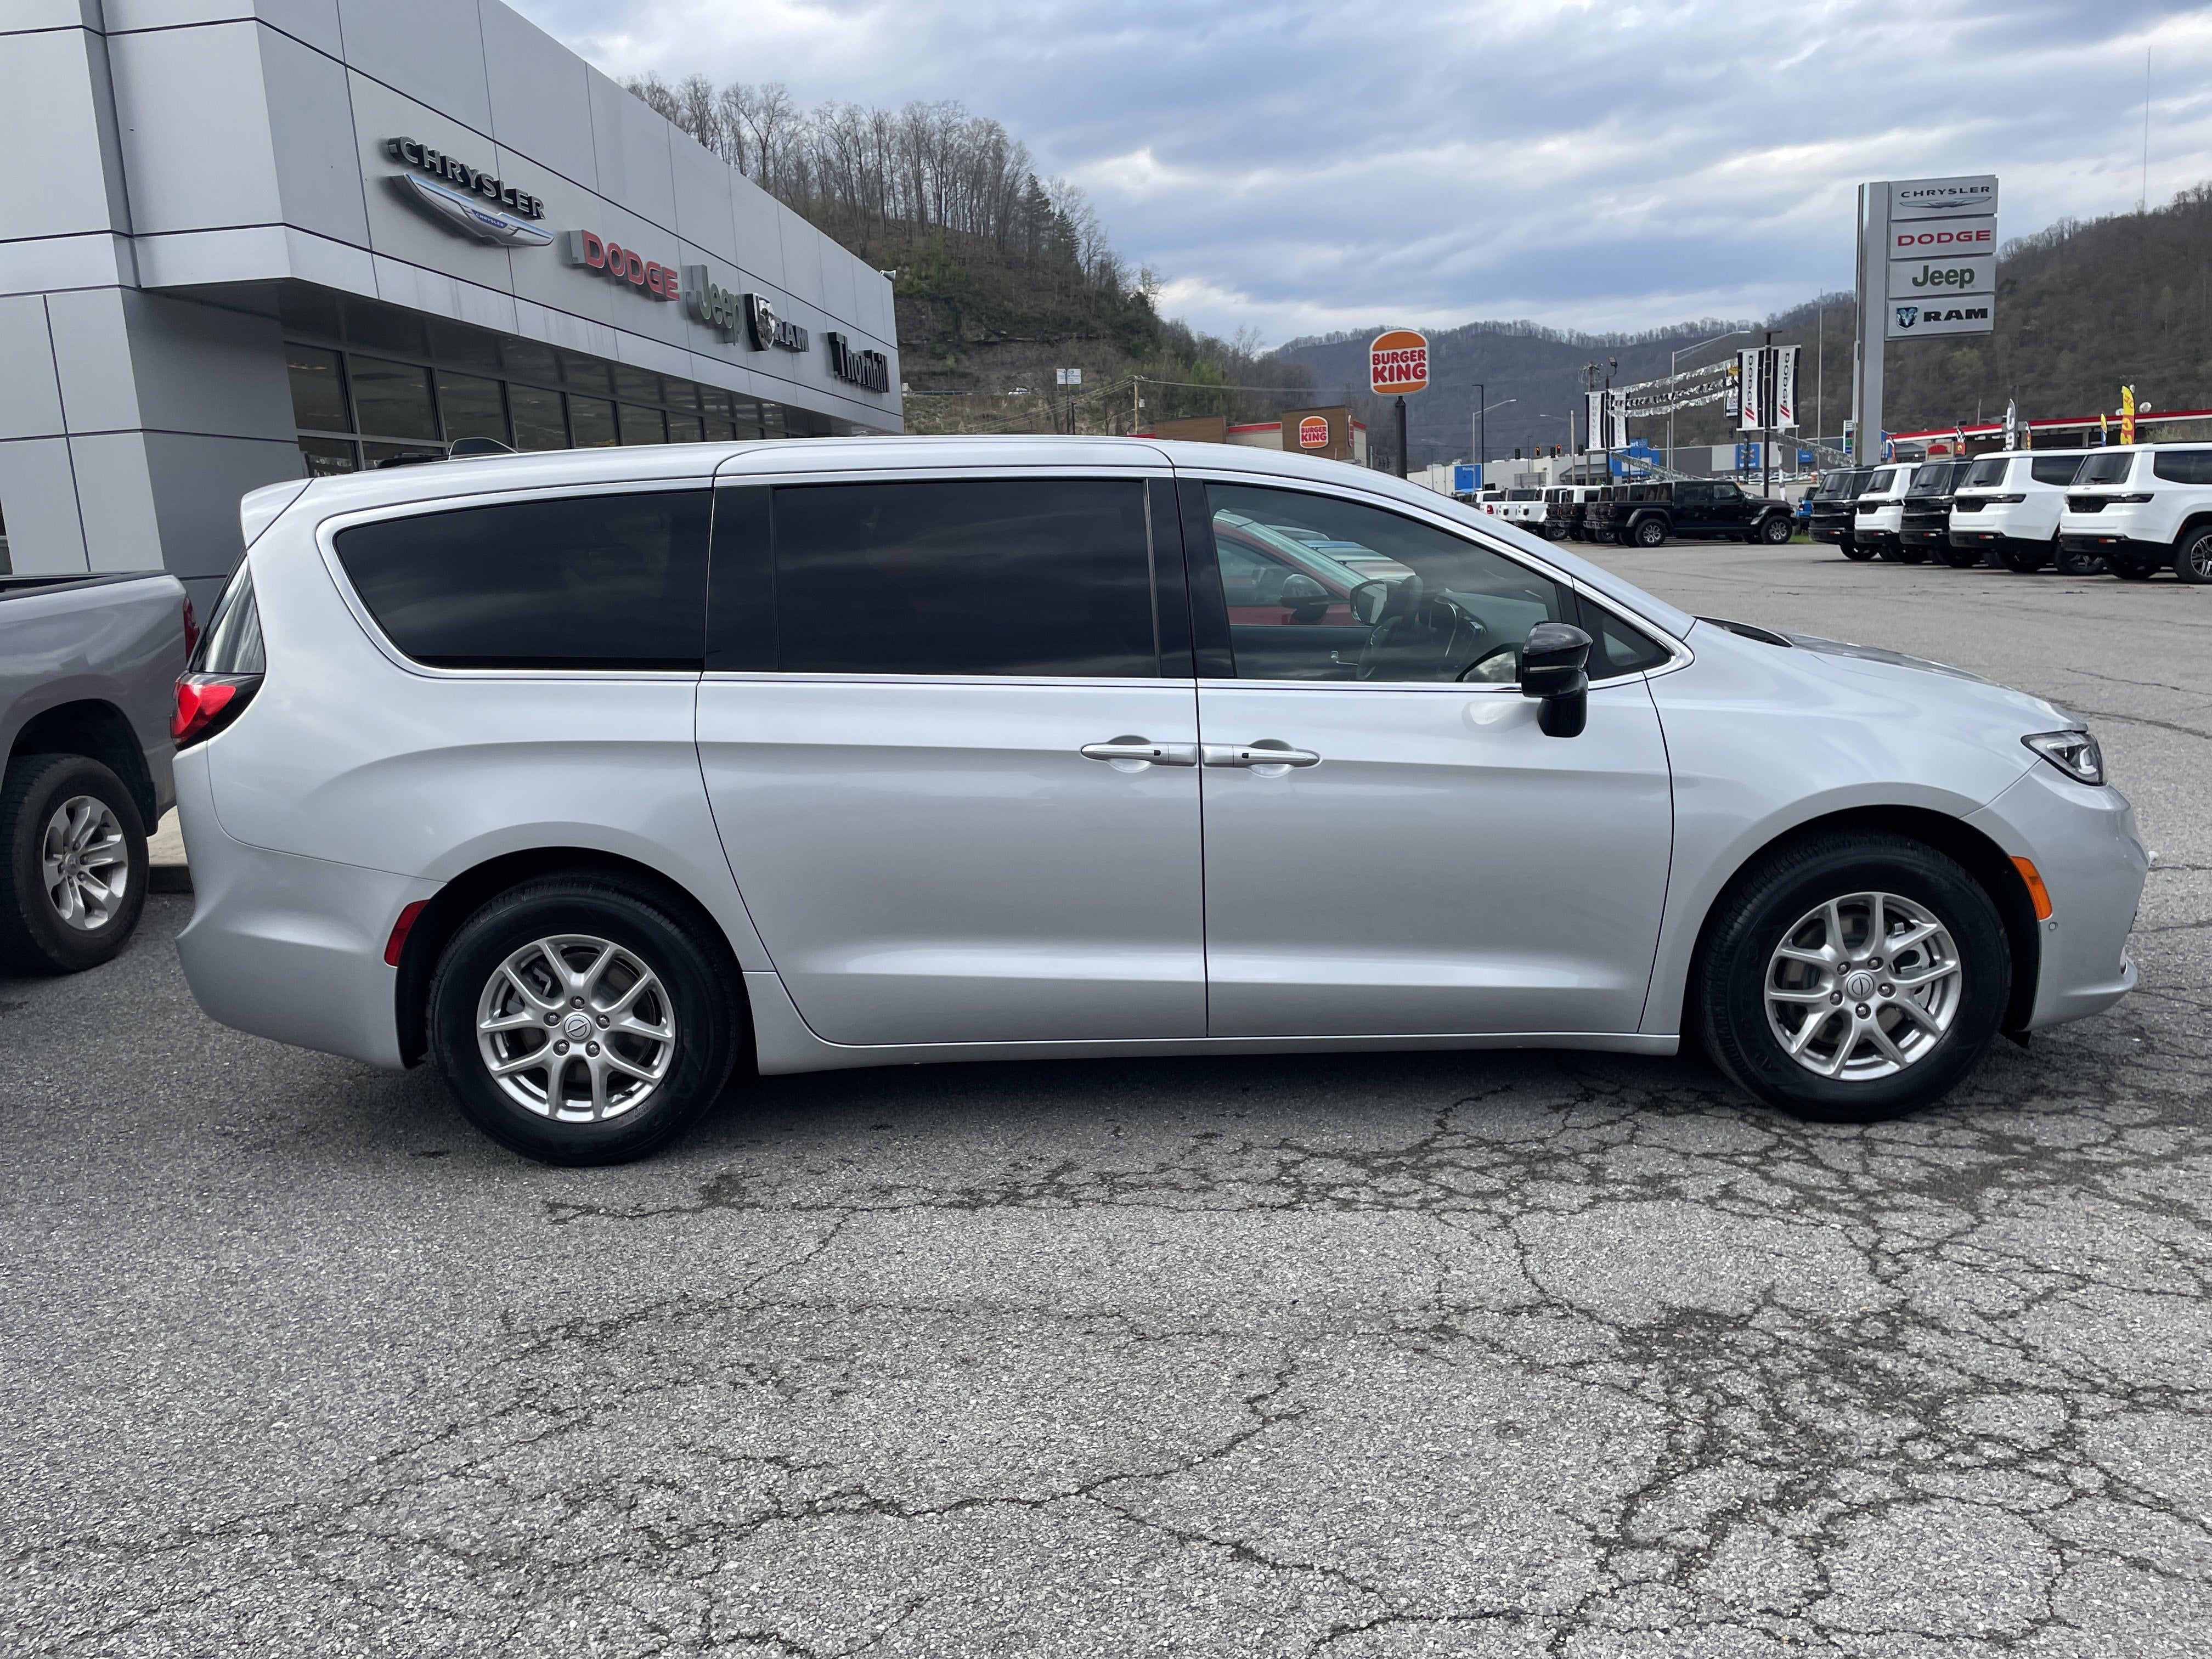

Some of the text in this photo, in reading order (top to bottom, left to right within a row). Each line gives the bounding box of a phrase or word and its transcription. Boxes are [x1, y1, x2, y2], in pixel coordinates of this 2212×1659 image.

[396, 137, 546, 219] CHRYSLER
[1901, 186, 1990, 198] CHRYSLER
[1898, 230, 1991, 246] DODGE
[582, 229, 680, 301] DODGE
[1912, 265, 1974, 289] Jeep
[695, 265, 744, 346] Jeep
[1923, 308, 1988, 322] RAM
[775, 317, 809, 352] RAM
[831, 332, 890, 393] Thornhill
[1373, 349, 1426, 365] BURGER
[1373, 362, 1426, 383] KING
[1301, 432, 1327, 442] KING
